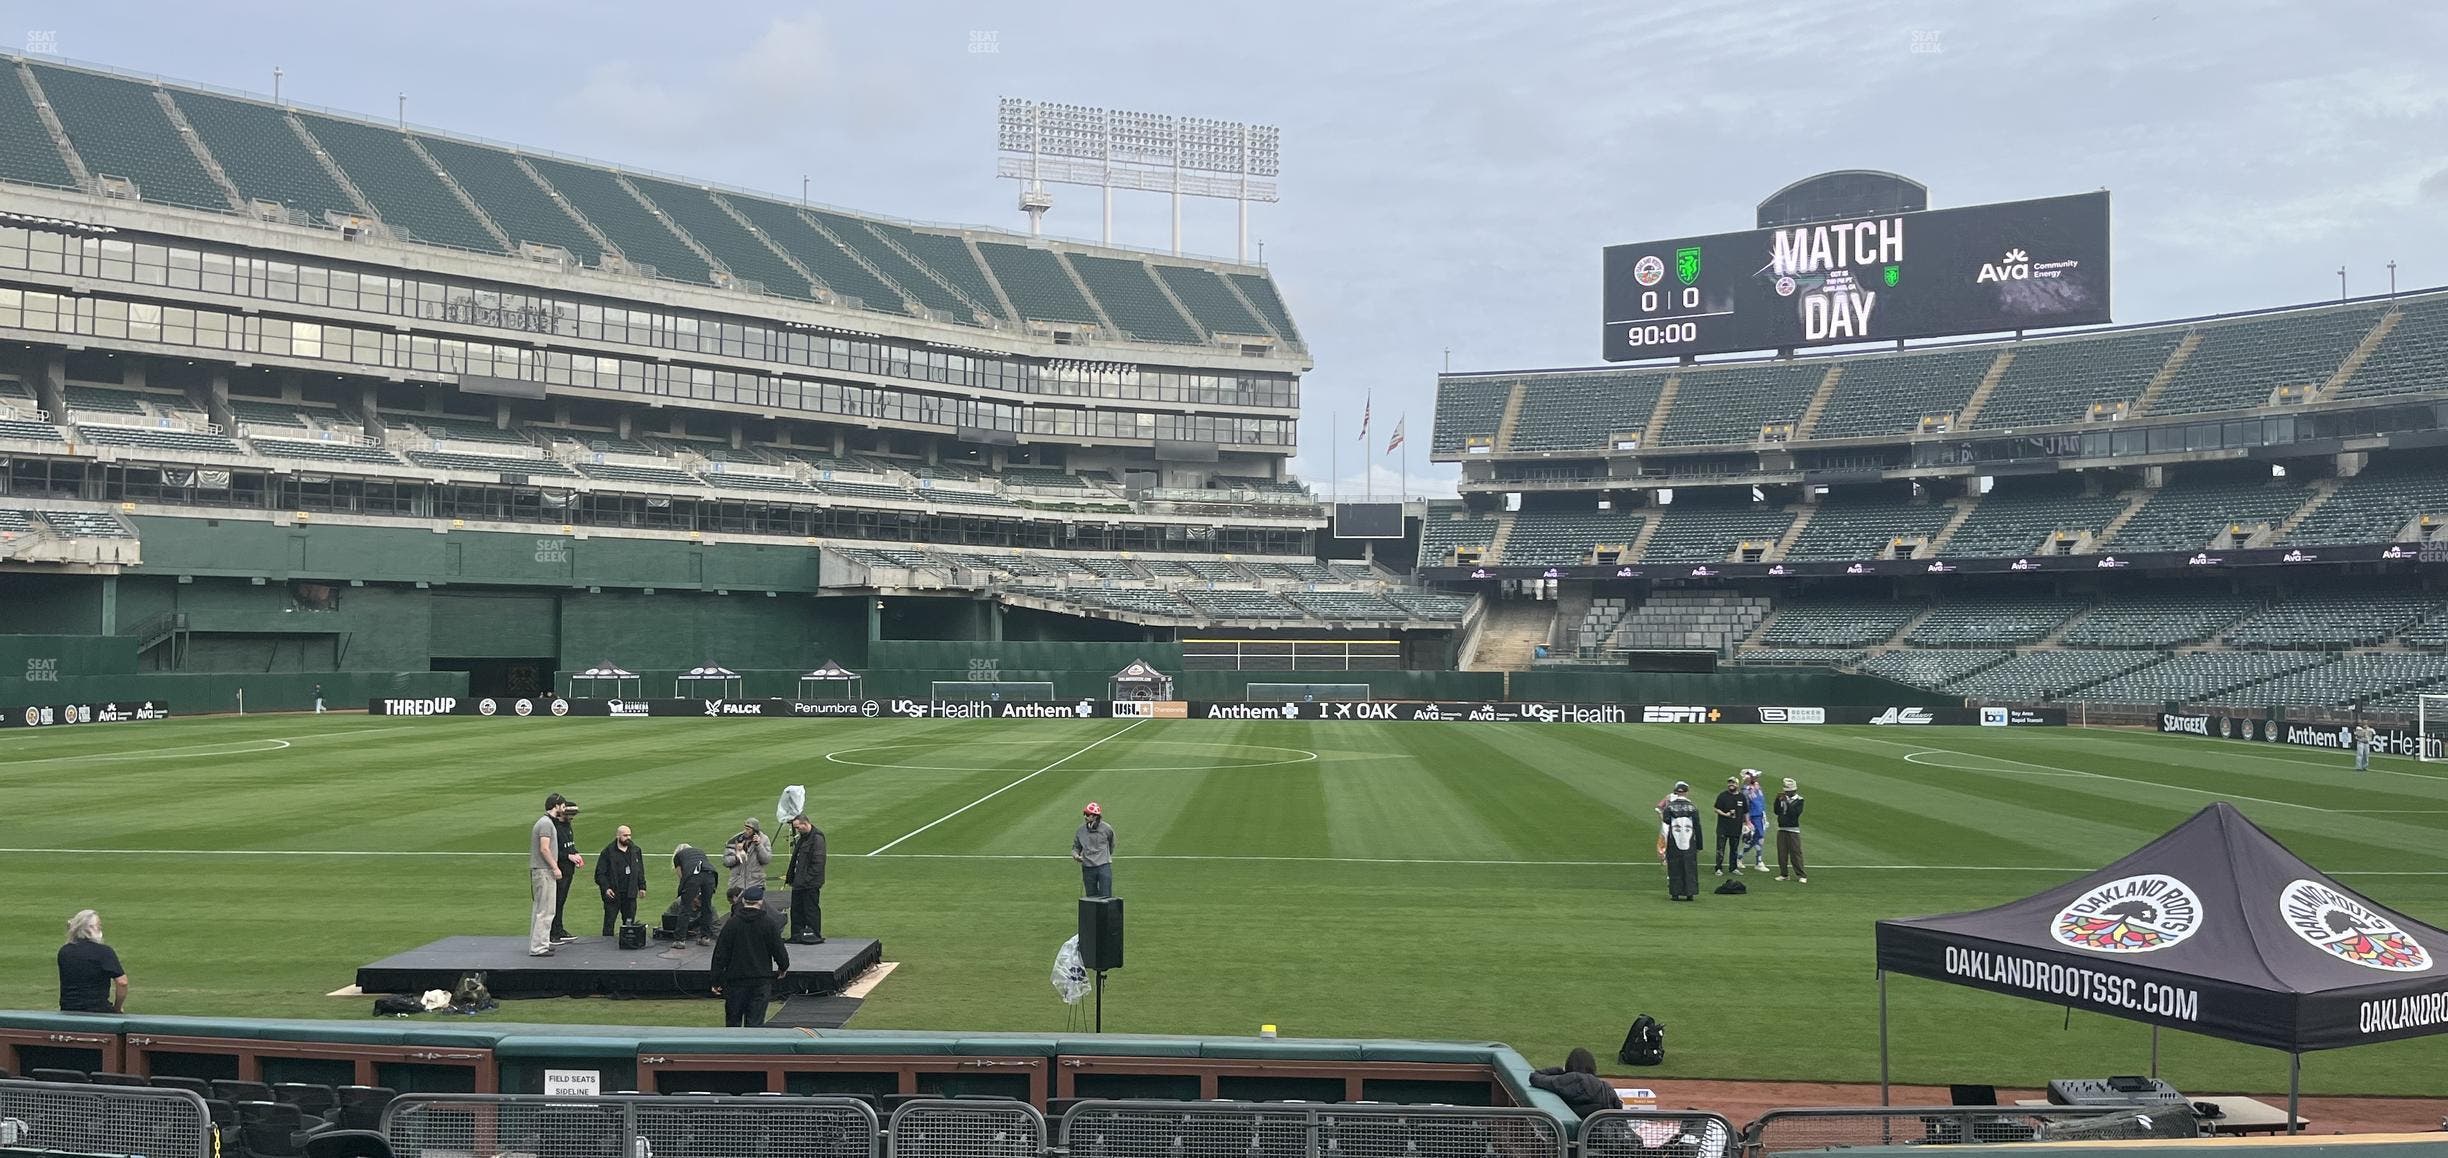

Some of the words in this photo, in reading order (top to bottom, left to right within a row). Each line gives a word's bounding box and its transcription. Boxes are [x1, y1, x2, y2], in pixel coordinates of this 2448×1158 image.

[1774, 218, 1903, 275] MATCH
[1976, 263, 2028, 283] Ava
[2034, 260, 2077, 271] Community
[2034, 270, 2061, 278] Energy
[1641, 291, 1657, 312] 0
[1683, 287, 1699, 308] 0
[1805, 291, 1876, 340] DAY
[1629, 322, 1697, 346] 90:00
[2283, 554, 2301, 562] Ava
[1928, 564, 1943, 572] Ava
[136, 708, 153, 719] Ava
[384, 697, 456, 715] THREDUP
[723, 704, 762, 714] FALCK
[794, 703, 857, 714] Penumbra
[891, 700, 928, 717] UCSF
[931, 700, 991, 718] Health
[1002, 702, 1072, 718] Anthem
[1208, 703, 1279, 719] Anthem
[1319, 703, 1328, 718] I
[1357, 703, 1396, 719] OAK
[1521, 704, 1559, 722] UCSF
[1561, 704, 1625, 723] Health
[98, 710, 116, 721] Ava
[1413, 710, 1439, 720] Ava
[1468, 710, 1494, 721] Ava
[1869, 707, 1933, 724] AC
[2163, 714, 2207, 735] SEATGEEK
[2287, 726, 2337, 747] Anthem
[2071, 880, 2167, 913] OAKLAND
[2156, 888, 2193, 932] ROOTS
[2288, 885, 2331, 940] OAKLAND
[2322, 888, 2389, 929] ROOTS
[1945, 946, 2197, 1022] OAKLANDROOTSSC.COM
[549, 1075, 570, 1083] FIELD
[572, 1075, 596, 1084] SEATS
[556, 1088, 589, 1096] SIDELINE
